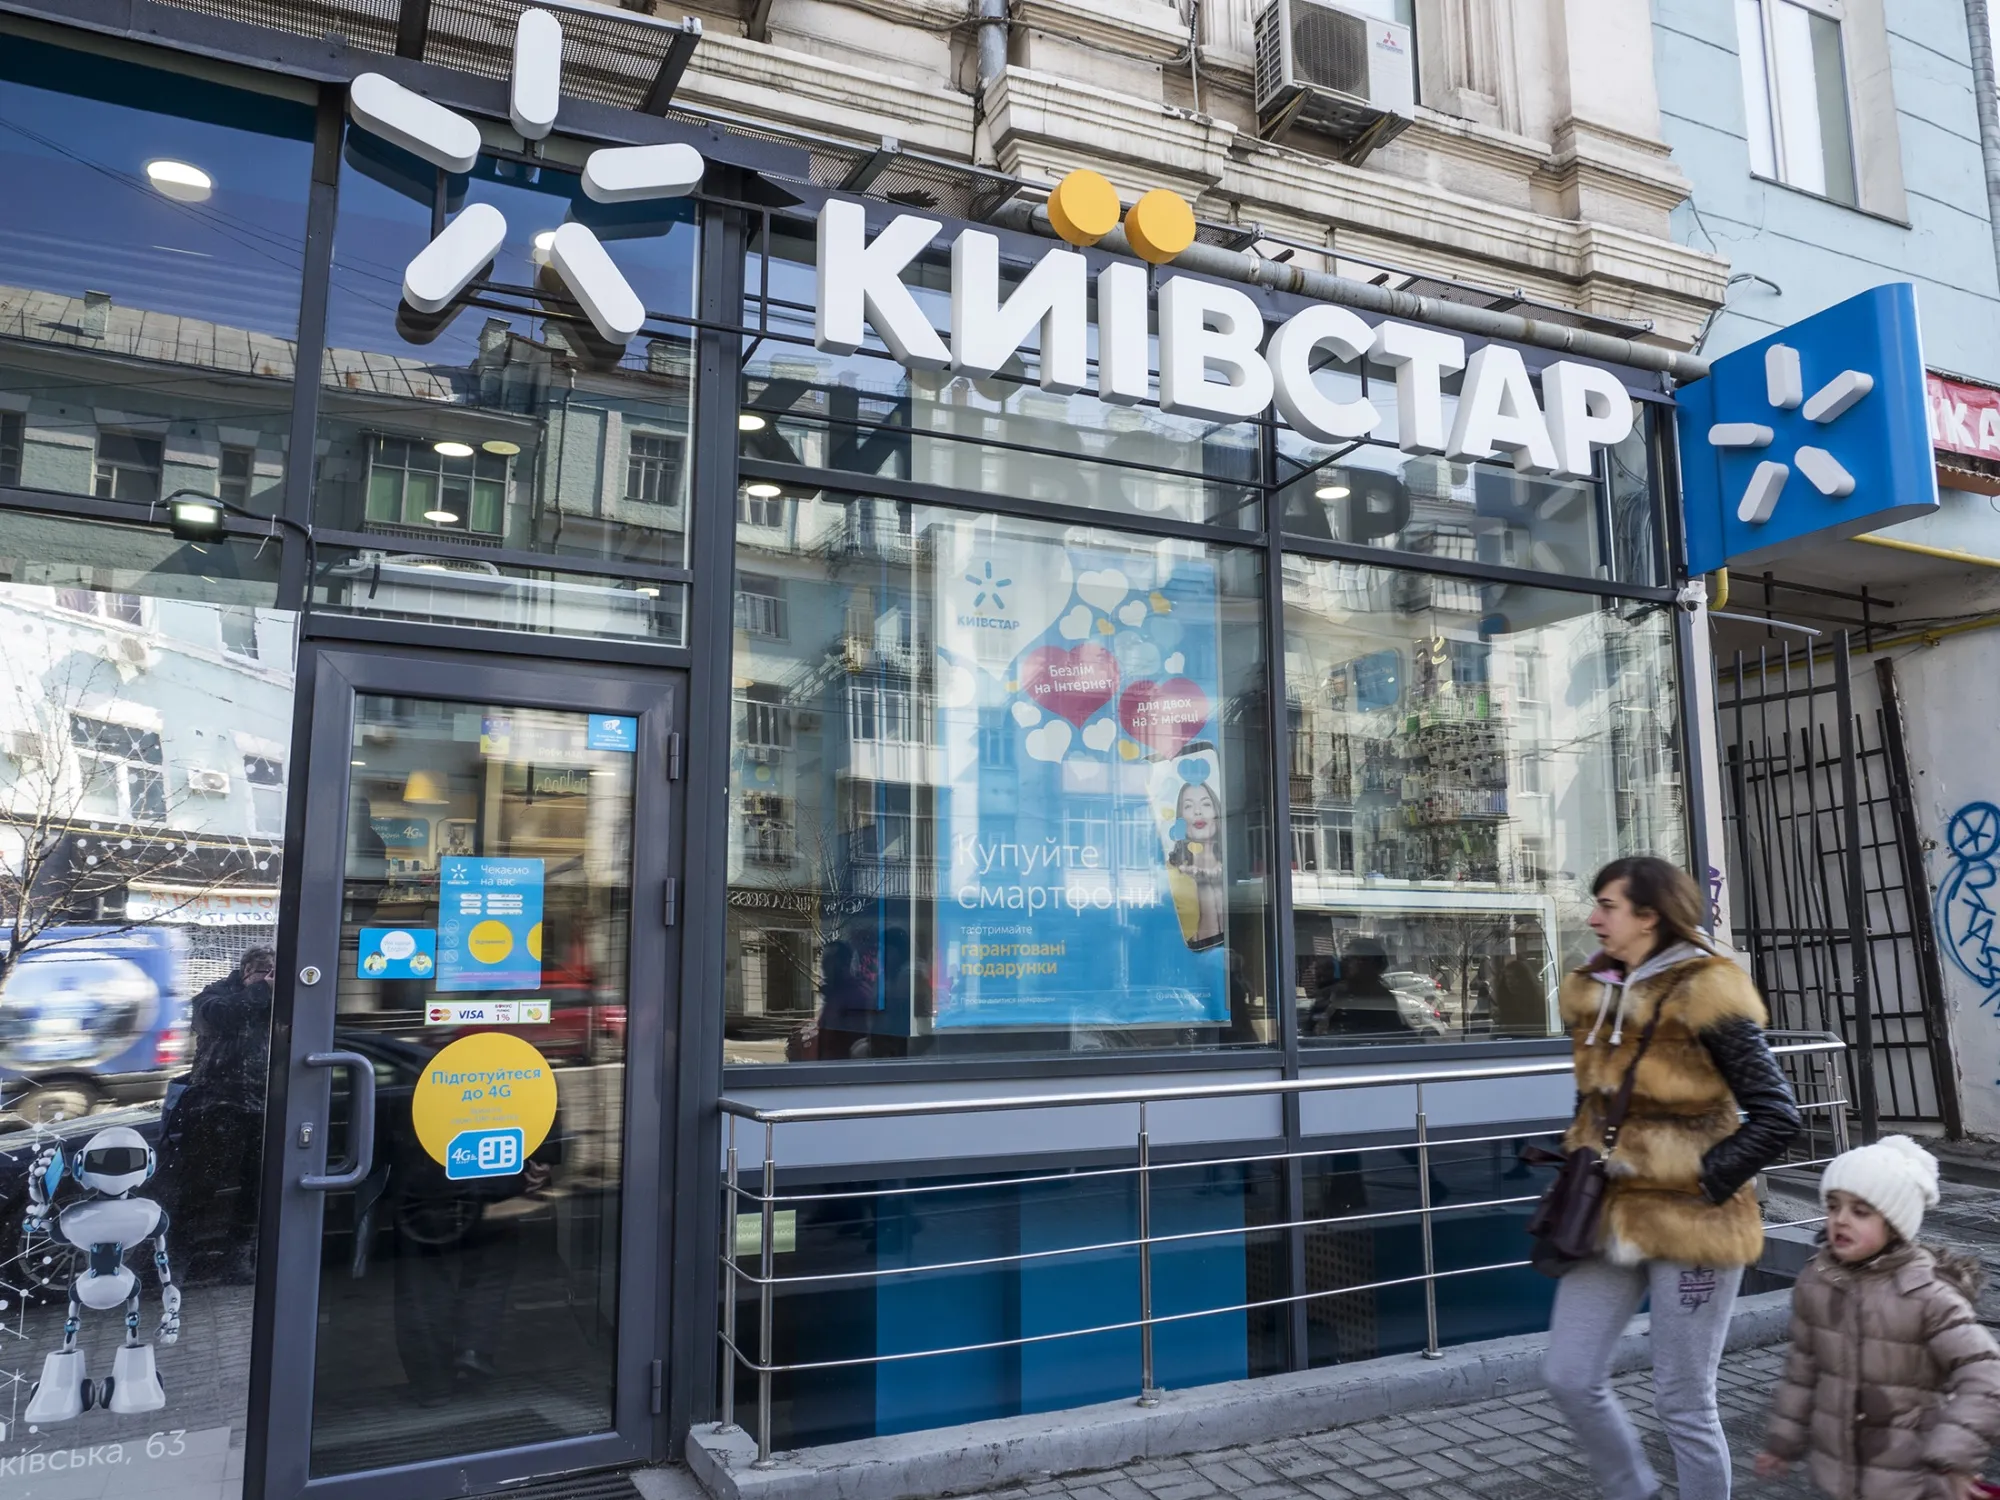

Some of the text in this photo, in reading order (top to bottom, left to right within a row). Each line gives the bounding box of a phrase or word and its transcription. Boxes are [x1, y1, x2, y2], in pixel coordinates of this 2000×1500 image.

[815, 170, 1633, 481] КИЇВСТАР
[957, 612, 1020, 630] КИЇВСТАР
[1049, 664, 1094, 677] Безлім
[1034, 679, 1112, 694] на Інтернет
[1137, 698, 1191, 713] для двох
[1132, 711, 1199, 727] на 3 місяці
[958, 834, 1099, 876] Купуйте
[481, 864, 529, 875] Чекаємо
[481, 878, 516, 886] на вас
[958, 880, 1155, 918] смартфони
[974, 924, 1032, 935] отримайте
[961, 940, 1066, 959] гарантовані
[961, 960, 1057, 979] подарунки
[459, 1010, 484, 1019] VISA
[432, 1068, 541, 1085] Підготуйтеся
[461, 1084, 511, 1101] до 4G
[451, 1148, 471, 1161] 4G
[146, 1429, 186, 1459] 63
